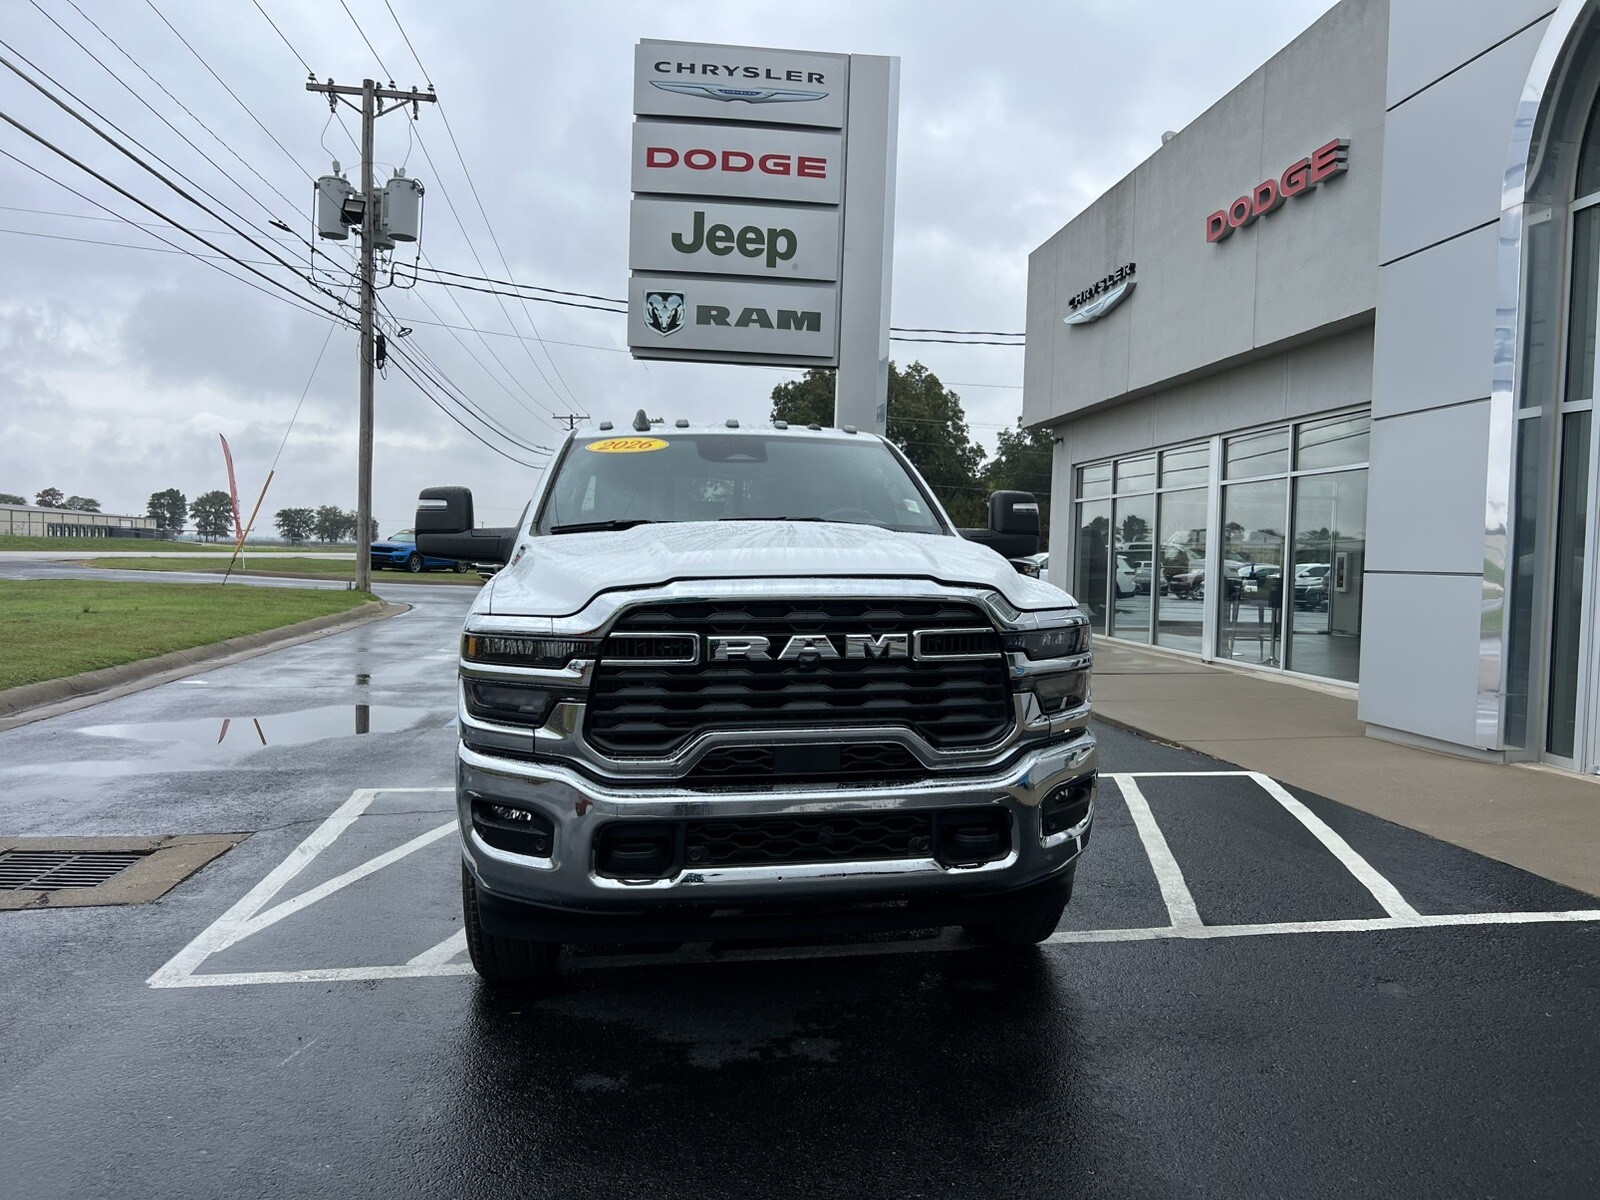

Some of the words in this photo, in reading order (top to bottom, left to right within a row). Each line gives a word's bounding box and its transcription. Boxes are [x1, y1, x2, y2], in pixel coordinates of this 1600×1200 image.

[654, 61, 825, 85] CHRYSLER
[646, 146, 827, 179] DODGE
[1206, 138, 1350, 243] DODGE
[671, 211, 798, 268] Jeep
[1067, 262, 1136, 310] CHRYSLER
[696, 304, 822, 333] RAM
[596, 437, 654, 452] 2026
[707, 632, 909, 662] RAM
